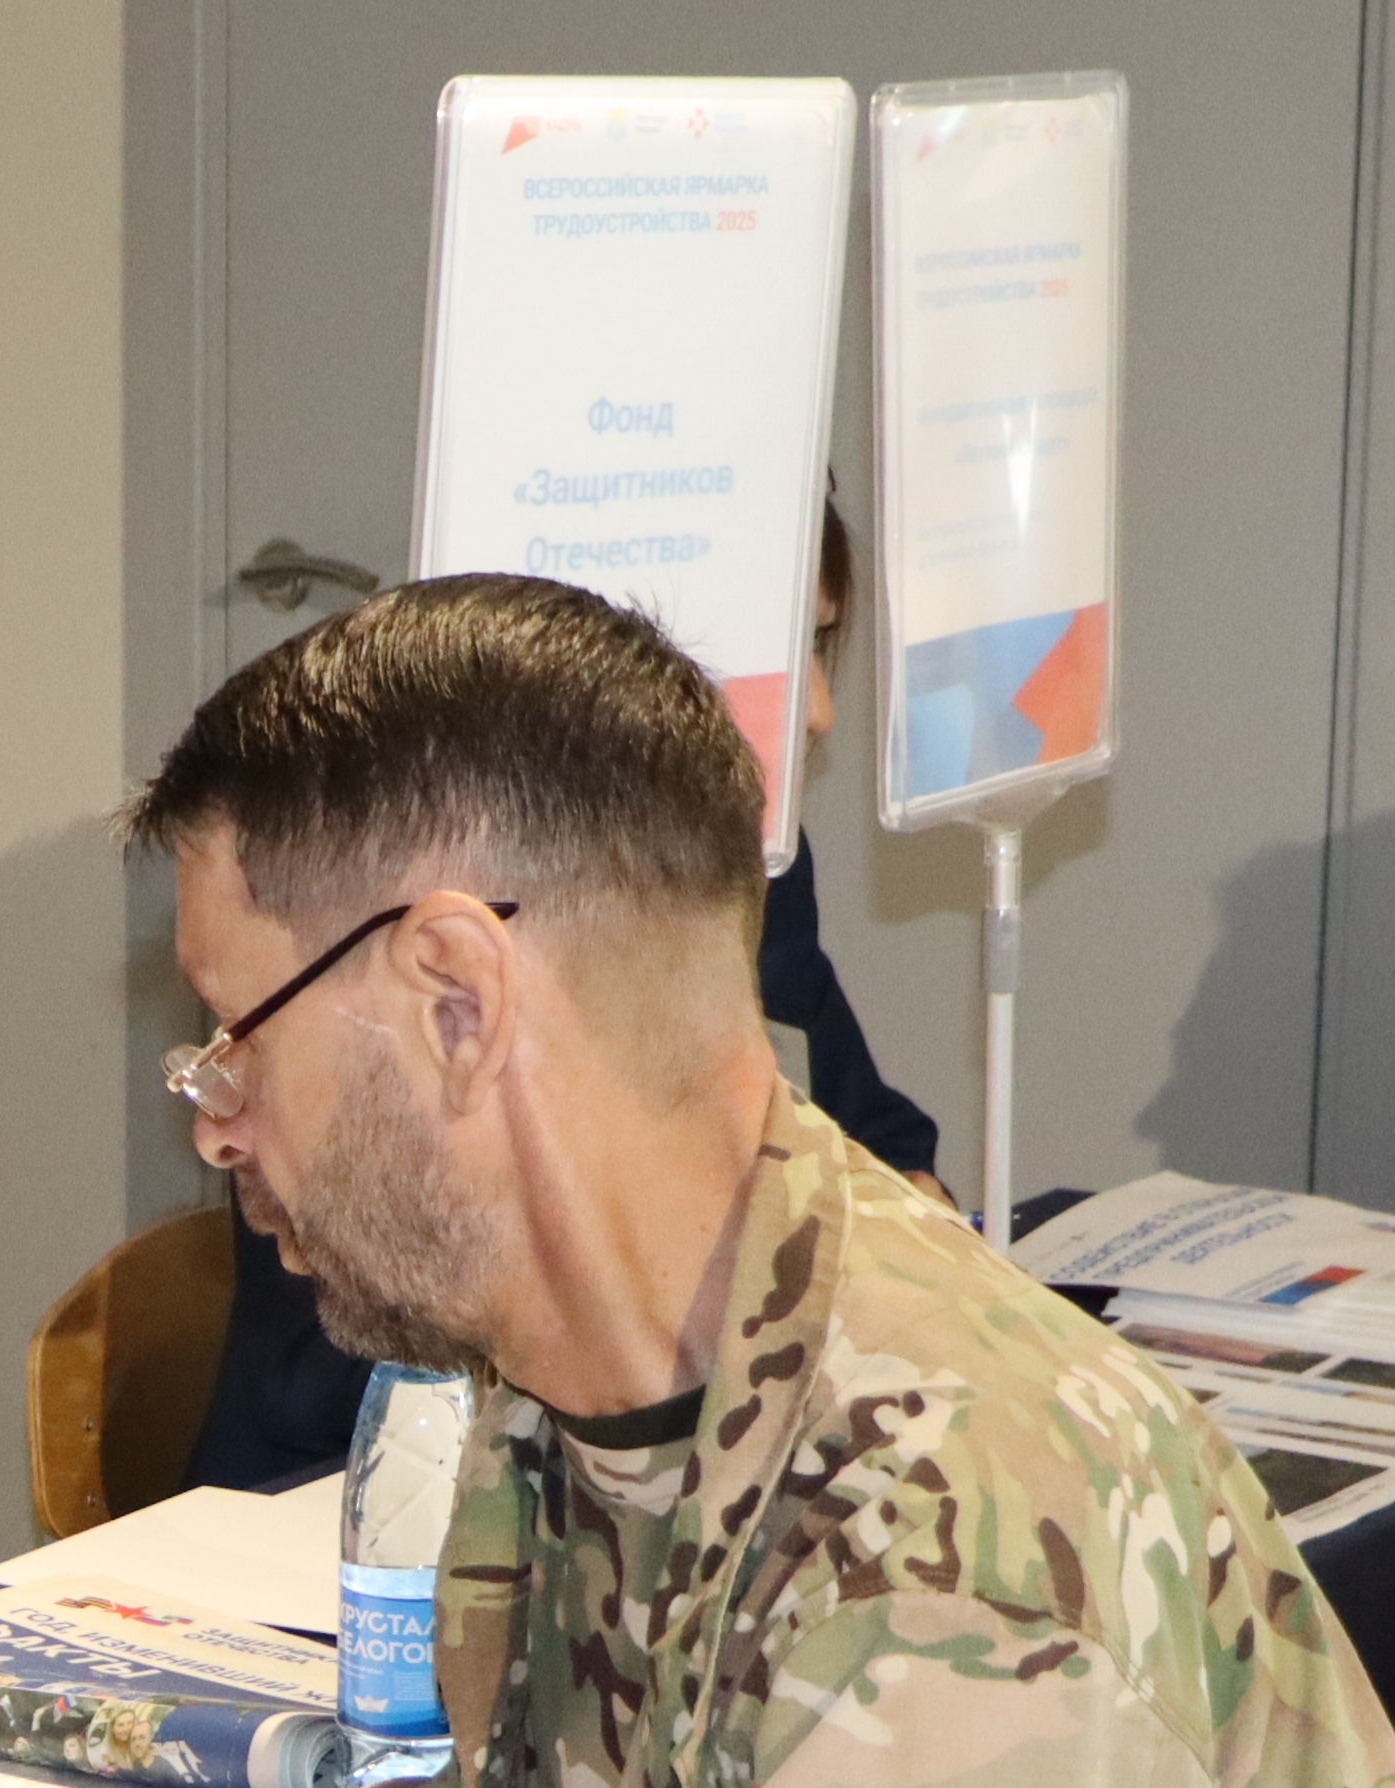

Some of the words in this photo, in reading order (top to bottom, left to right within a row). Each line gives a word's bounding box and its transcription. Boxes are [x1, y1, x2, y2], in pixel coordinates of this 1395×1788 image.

[523, 173, 680, 200] ВСЕРОССИЙСКАЯ
[684, 175, 769, 197] ЯРМАРКА
[533, 208, 711, 238] ТРУДОУСТРОЙСТВА
[716, 210, 757, 232] 2025
[587, 396, 674, 438] Фонд
[514, 467, 733, 508] «Защитников
[526, 534, 712, 572] Отечества»
[78, 1632, 301, 1691] ИЗМЕНИВШИЙ
[183, 1633, 310, 1665] ОТЕЧЕСТВА
